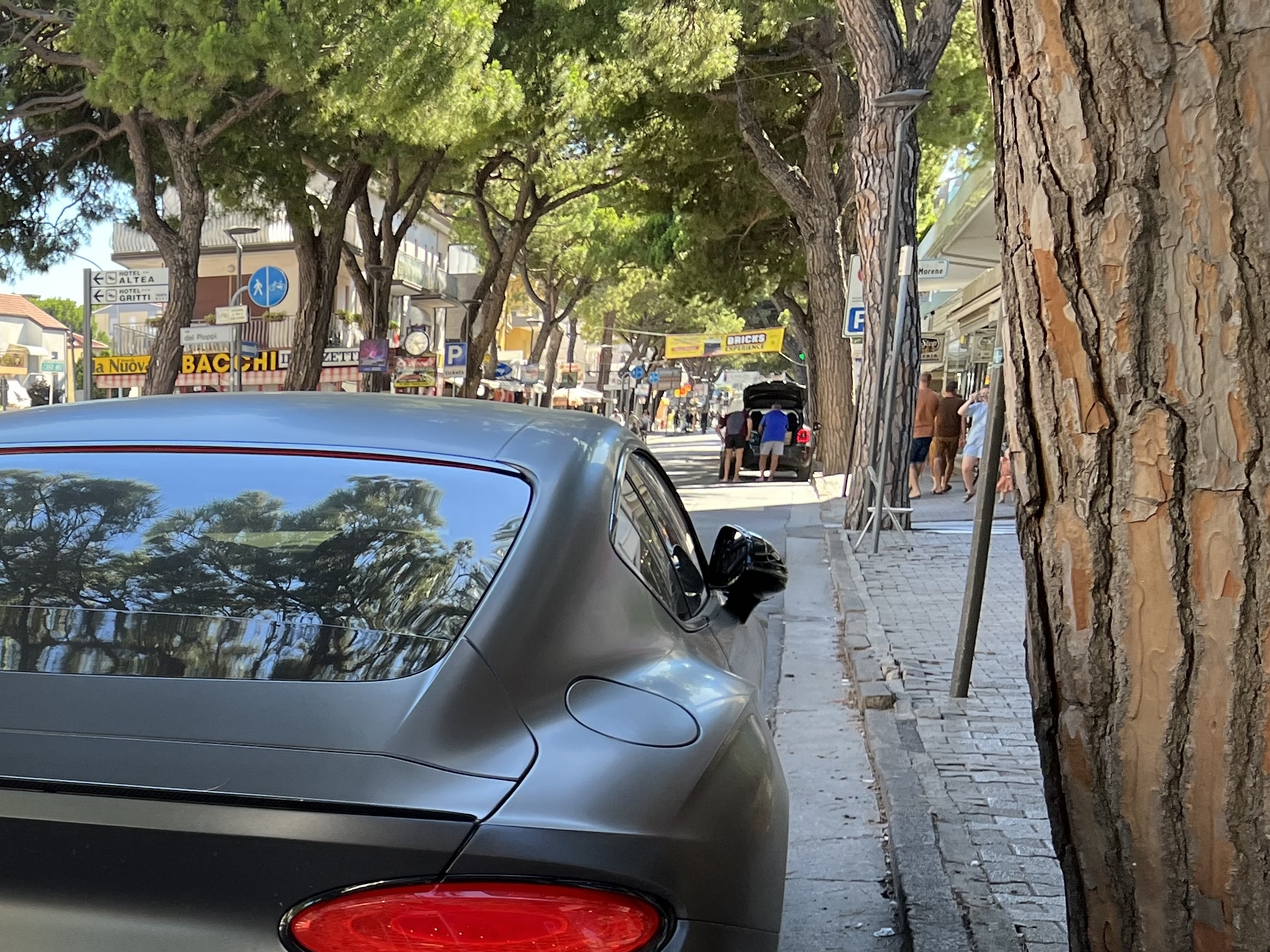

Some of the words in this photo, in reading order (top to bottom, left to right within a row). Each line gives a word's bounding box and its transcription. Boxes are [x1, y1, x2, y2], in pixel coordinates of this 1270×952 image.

[119, 276, 155, 284] ALTEA
[119, 294, 151, 302] GRITTI
[727, 333, 766, 346] BRICKS
[447, 344, 463, 365] P
[182, 351, 277, 374] BACCHI
